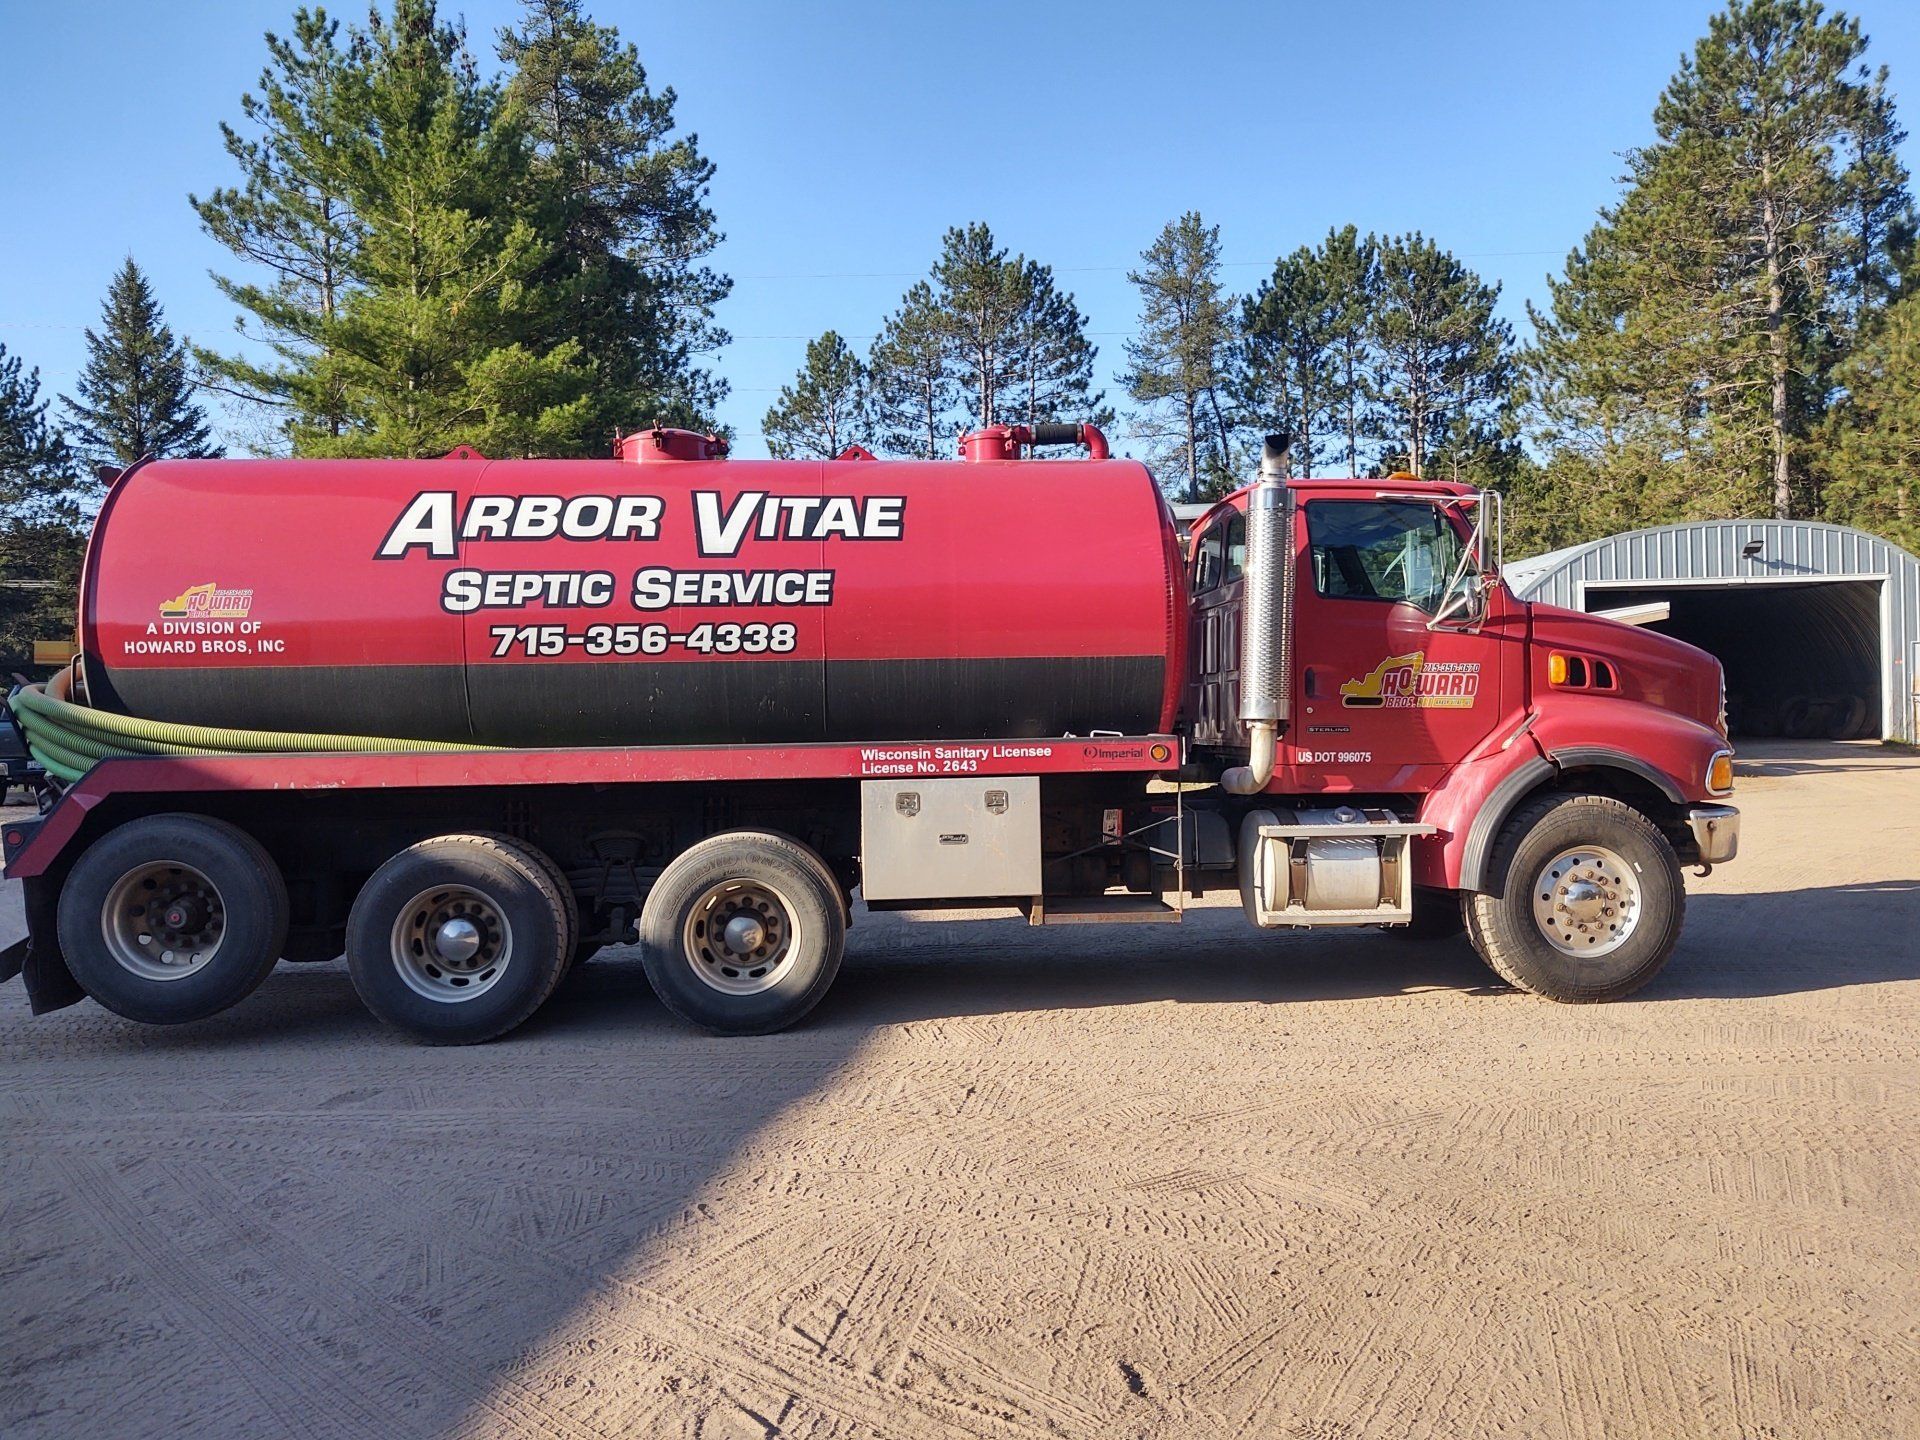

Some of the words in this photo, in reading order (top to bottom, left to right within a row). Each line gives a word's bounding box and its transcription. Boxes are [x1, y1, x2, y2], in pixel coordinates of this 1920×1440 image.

[376, 491, 664, 558] ARBOR
[692, 491, 905, 557] VITAE
[442, 569, 615, 612] SEPTIC
[632, 567, 834, 610] SERVICE
[187, 592, 252, 610] HOWARD
[146, 622, 158, 635] A
[163, 621, 234, 635] DIVISION
[240, 621, 262, 634] OF
[490, 621, 798, 656] 715-356-4338
[124, 641, 196, 654] HOWARD
[202, 640, 252, 655] BROS,
[257, 640, 285, 653] INC
[1382, 667, 1479, 697] HOWARD
[1386, 697, 1417, 708] BROS.
[861, 749, 931, 761] Wisconsin
[934, 747, 989, 761] Sanitary
[993, 746, 1052, 758] Licensee
[1099, 748, 1143, 760] Imperial
[1298, 751, 1313, 763] US
[1314, 751, 1336, 763] DOT
[1337, 751, 1372, 763] 996075
[862, 762, 914, 774] License
[917, 761, 939, 773] No.
[943, 760, 978, 772] 2643
